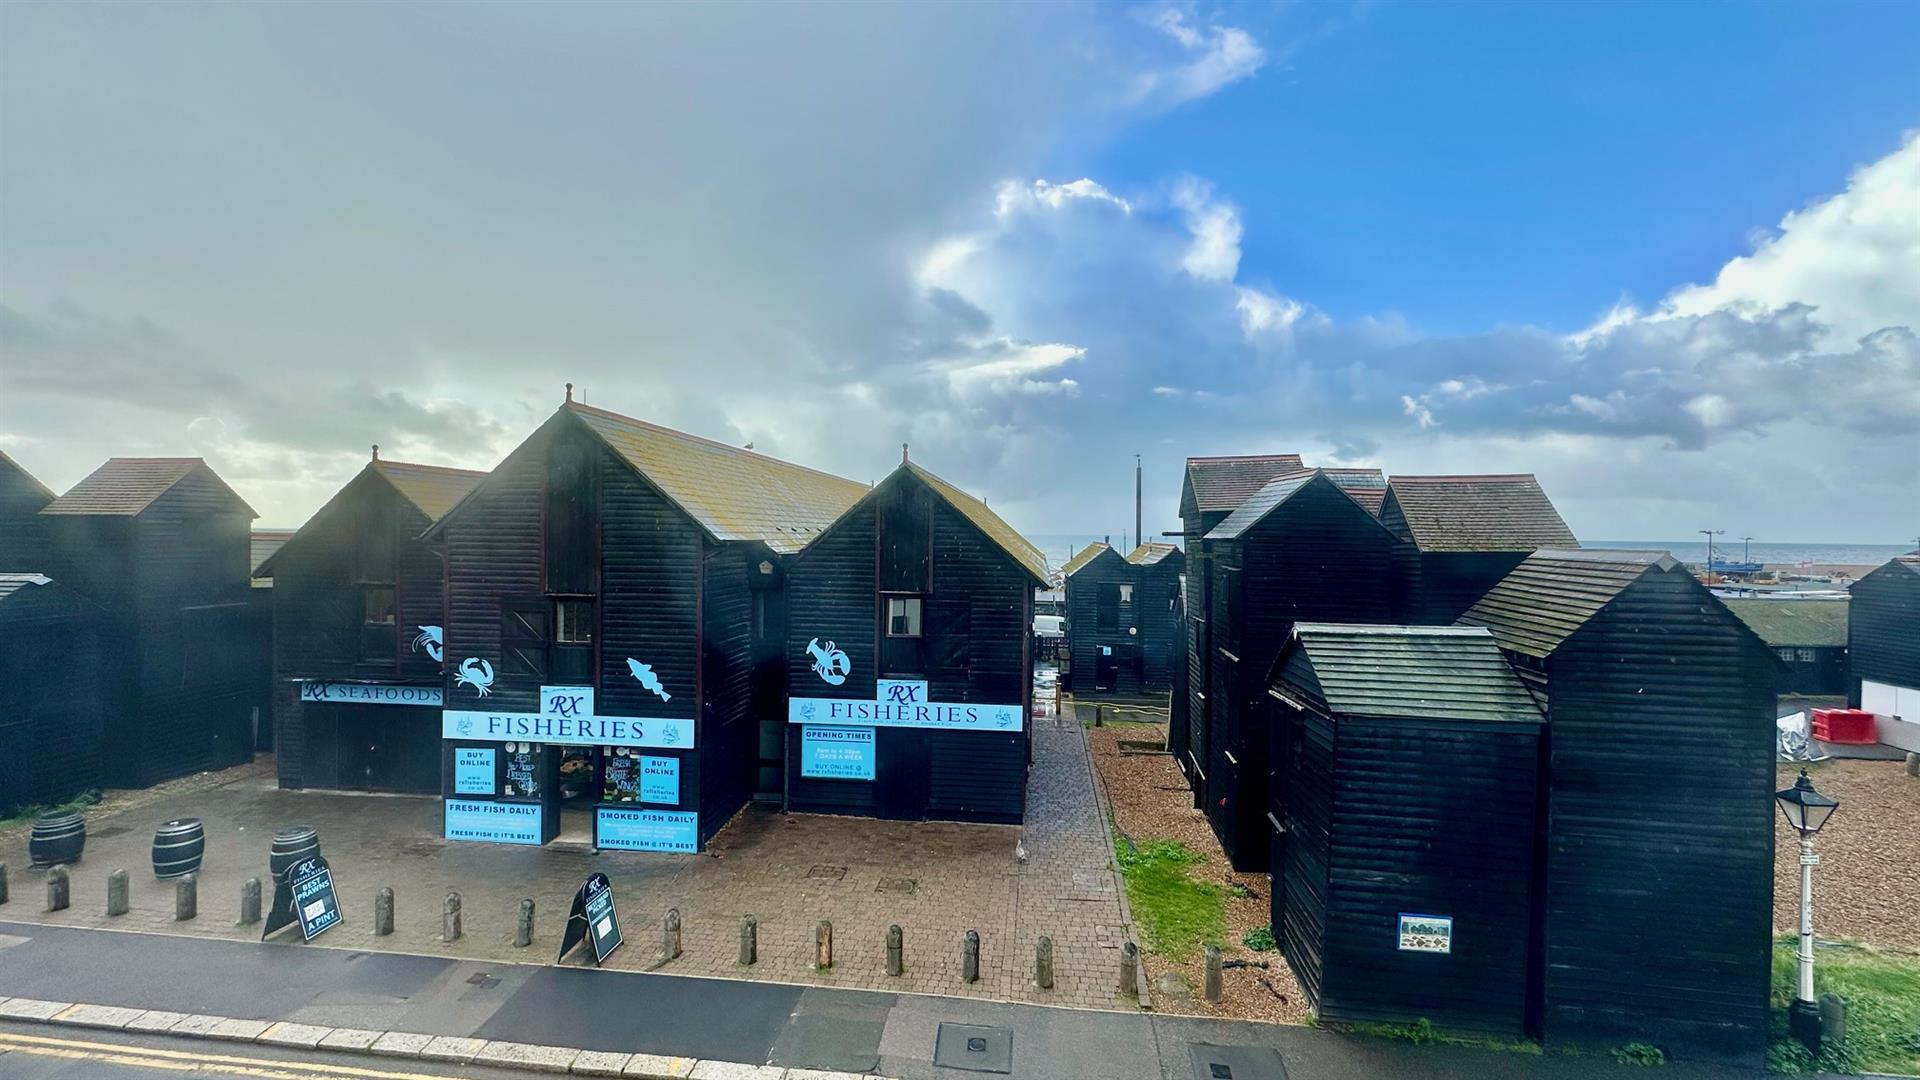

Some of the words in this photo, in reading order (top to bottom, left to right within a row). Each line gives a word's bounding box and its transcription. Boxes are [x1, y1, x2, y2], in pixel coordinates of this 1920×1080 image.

[304, 681, 331, 701] RX
[339, 687, 441, 701] SEAFOODS
[887, 685, 920, 705] RX
[549, 695, 584, 717] RX
[831, 702, 977, 723] FISHERIES
[488, 716, 643, 739] FISHERIES
[806, 731, 844, 739] OPENING
[644, 768, 675, 776] ONLINE
[449, 804, 480, 812] FRESH
[509, 807, 536, 815] DAILY
[600, 812, 639, 820] SMOKED
[643, 814, 664, 822] FISH
[299, 859, 316, 875] RX
[297, 880, 330, 901] PRAWNS
[302, 877, 321, 891] BEST
[308, 922, 315, 931] A
[315, 910, 335, 926] PINT
